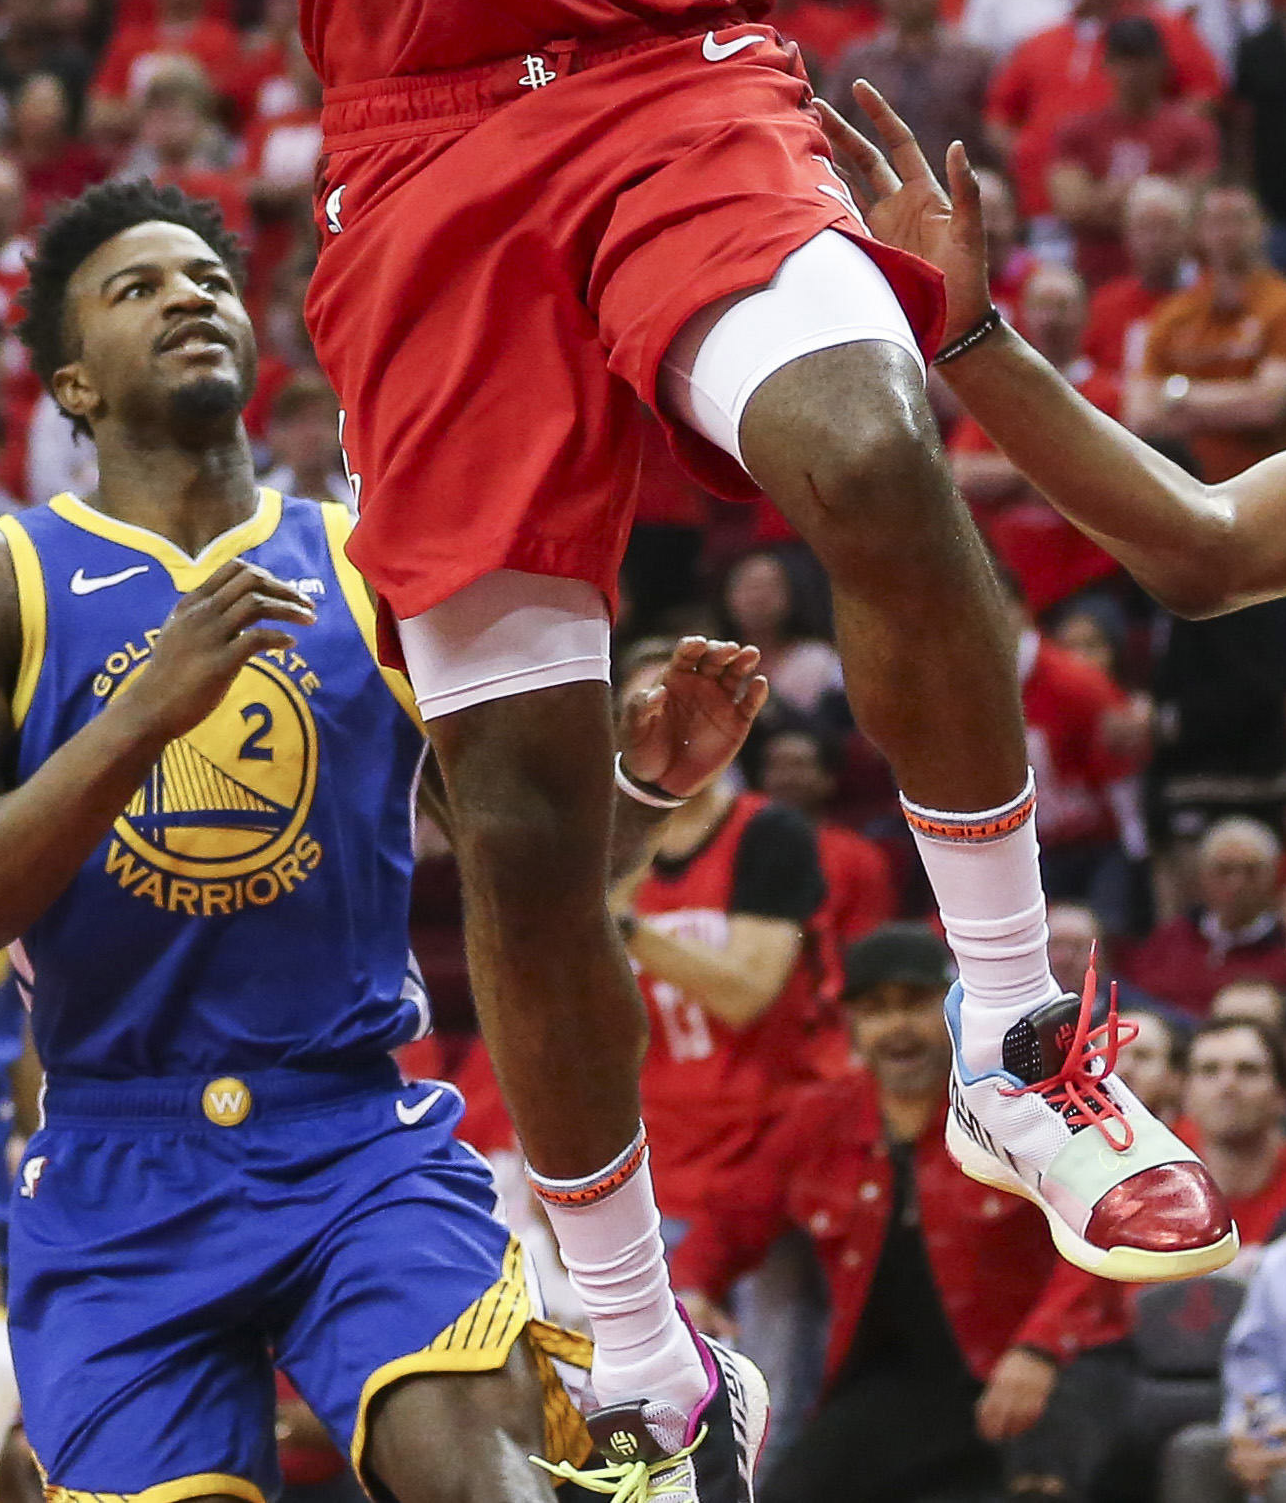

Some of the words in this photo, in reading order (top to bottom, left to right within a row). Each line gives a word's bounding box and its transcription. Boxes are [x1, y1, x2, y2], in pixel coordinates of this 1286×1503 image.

[92, 628, 162, 697] GOL
[238, 702, 275, 762] 2
[103, 832, 324, 917] WARRIORS
[209, 1091, 243, 1115] W
